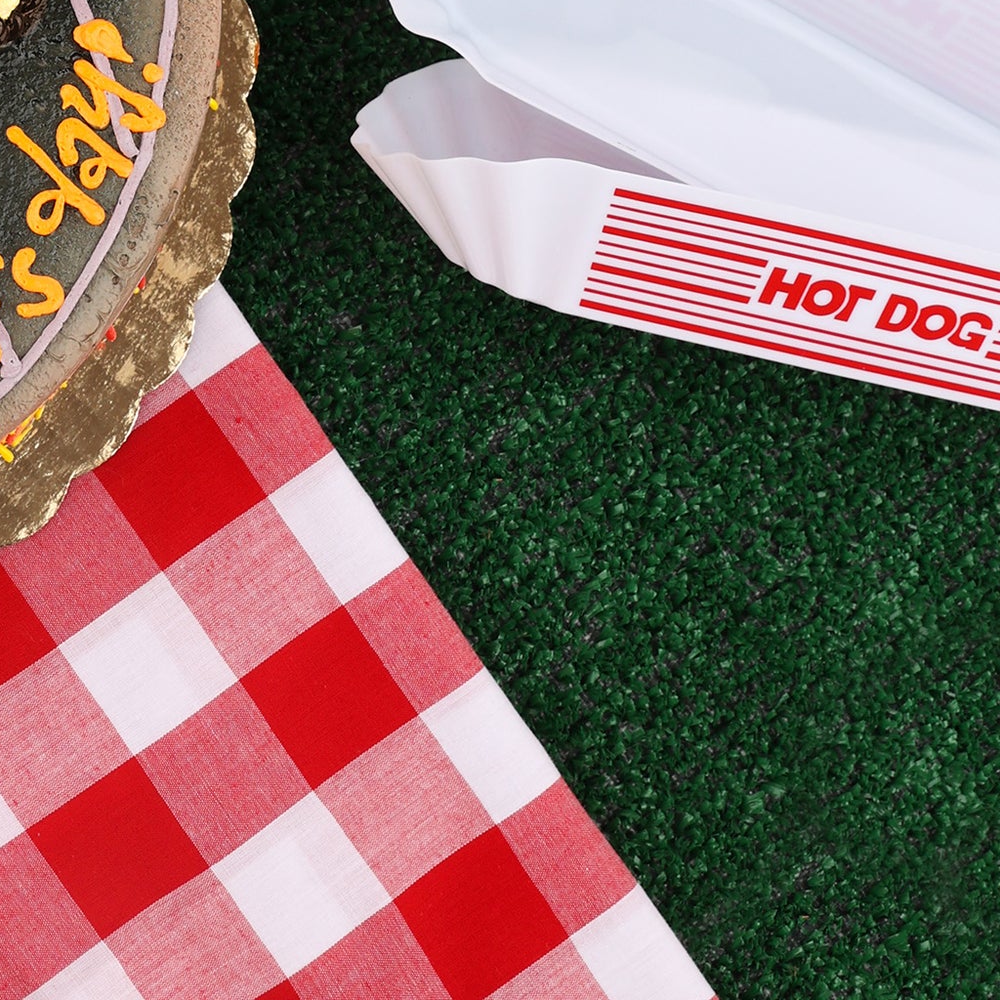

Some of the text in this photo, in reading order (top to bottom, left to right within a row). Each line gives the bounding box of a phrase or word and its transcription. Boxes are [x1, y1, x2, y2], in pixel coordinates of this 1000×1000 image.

[6, 18, 167, 236] day!
[757, 266, 994, 352] HOT DOG
